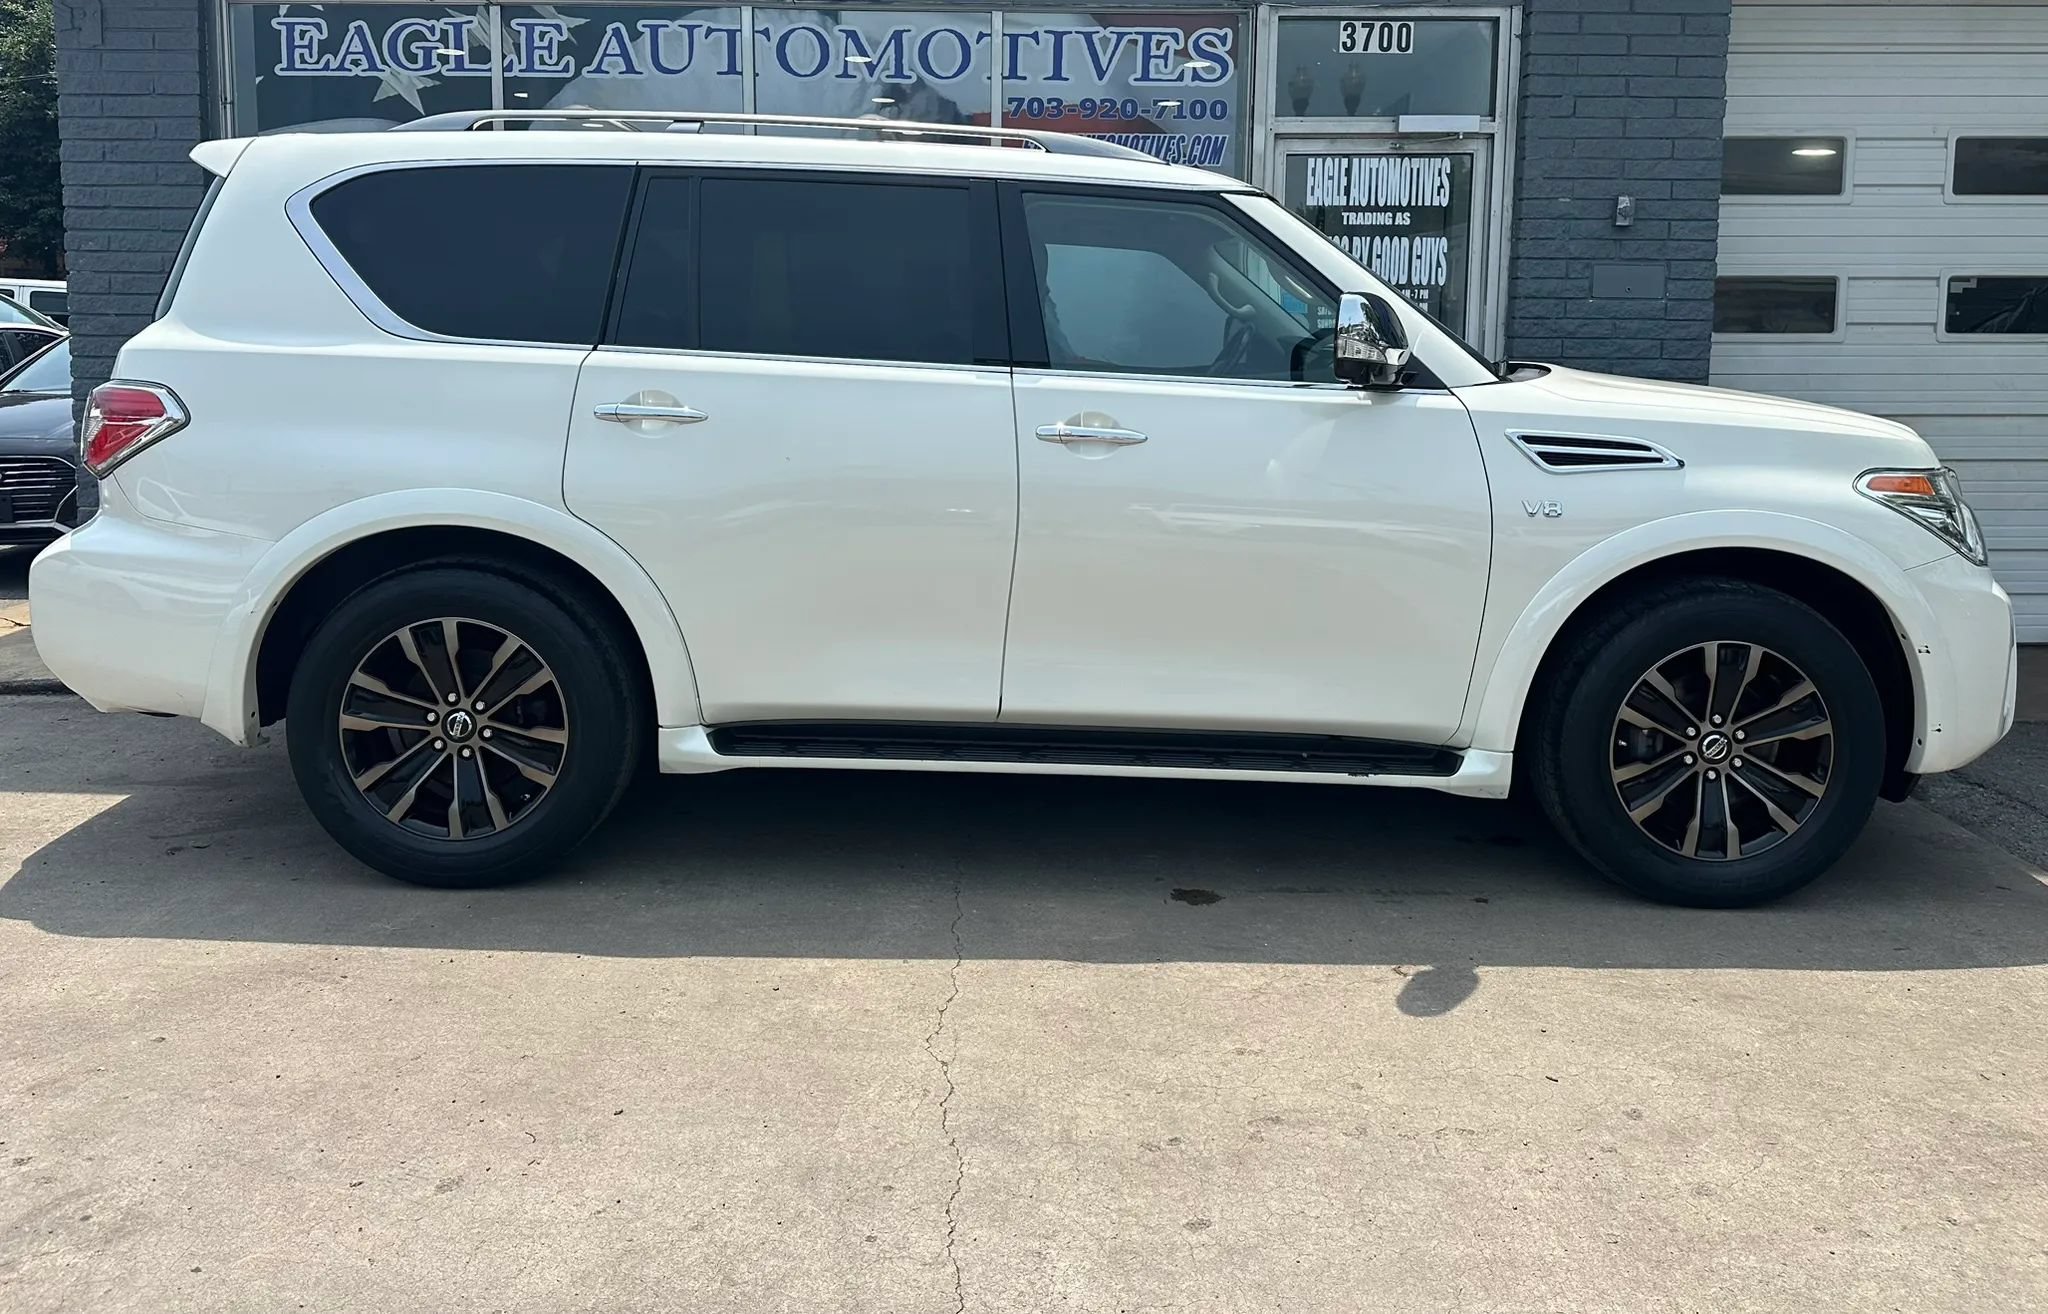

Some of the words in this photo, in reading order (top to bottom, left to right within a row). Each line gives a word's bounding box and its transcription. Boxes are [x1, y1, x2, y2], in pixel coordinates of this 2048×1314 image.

[273, 18, 573, 75] EAGLE
[584, 21, 1231, 85] AUTOMOTIVES
[1341, 22, 1411, 52] 3700
[1007, 97, 1228, 120] 703-920-7100
[1306, 157, 1348, 206] EAGLE
[1350, 157, 1450, 207] AUTOMOTIVES
[1342, 212, 1393, 225] TRADING
[1394, 212, 1411, 225] AS
[1371, 235, 1410, 286] GOOD
[1411, 236, 1448, 286] GUYS
[1520, 499, 1562, 518] V8
